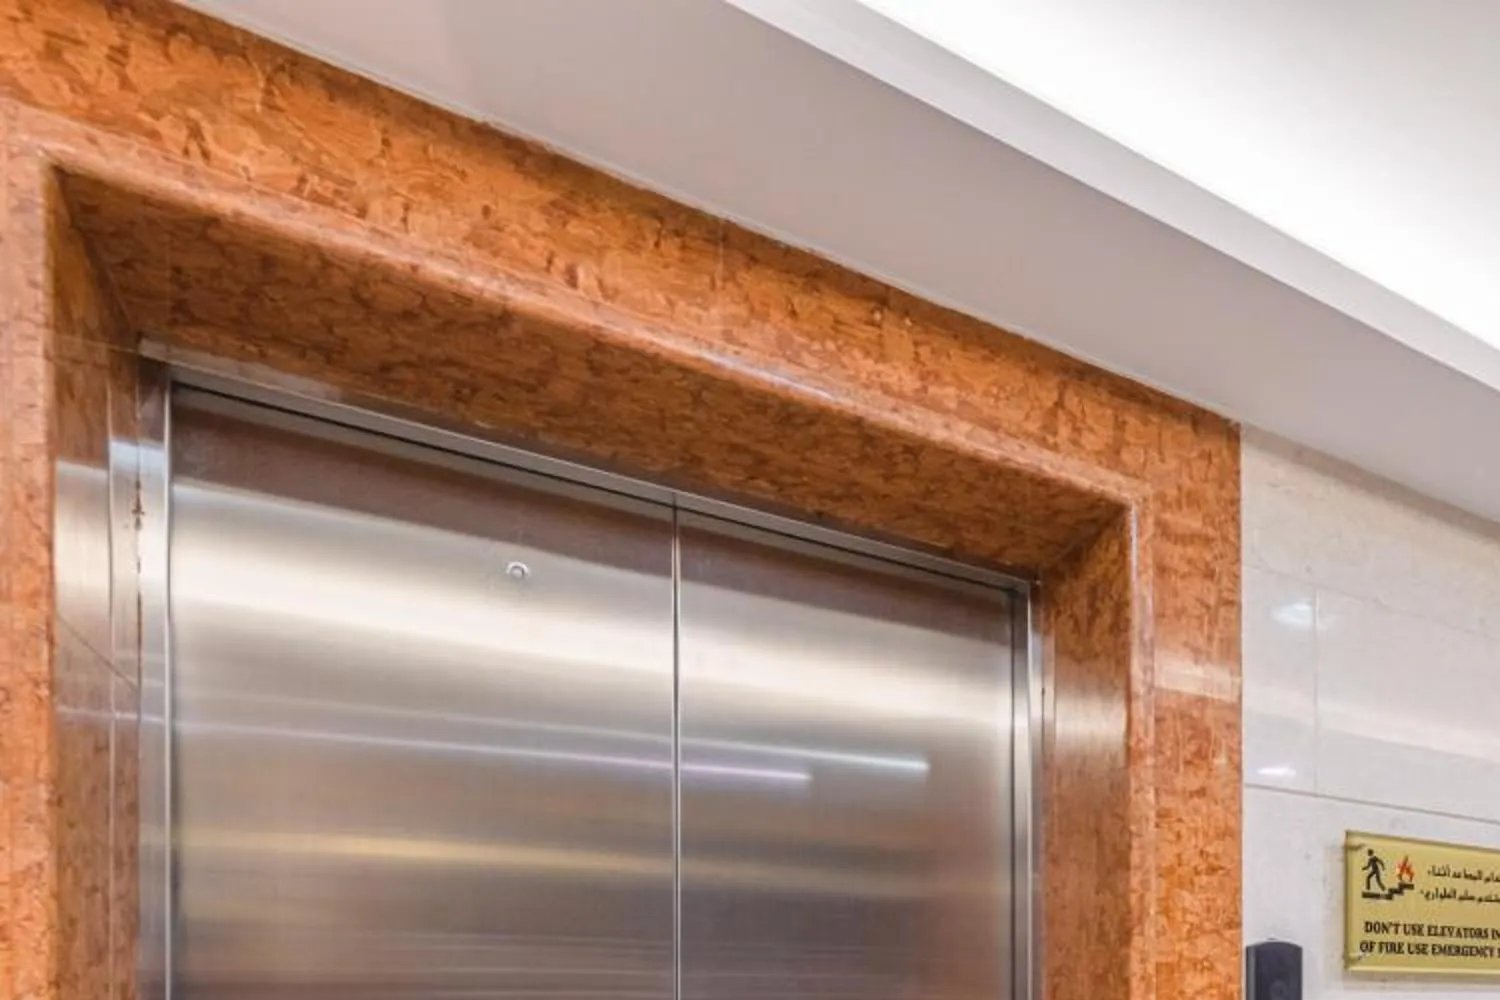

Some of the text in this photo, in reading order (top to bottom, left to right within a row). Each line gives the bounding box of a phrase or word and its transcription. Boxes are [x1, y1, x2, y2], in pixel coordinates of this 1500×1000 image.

[1364, 921, 1403, 935] DON'T
[1403, 924, 1425, 937] USE
[1427, 925, 1489, 939] ELEVATORS
[1359, 940, 1377, 953] OF
[1378, 941, 1406, 955] FIRE
[1407, 943, 1430, 956] USE
[1431, 944, 1495, 958] EMERGENCY
